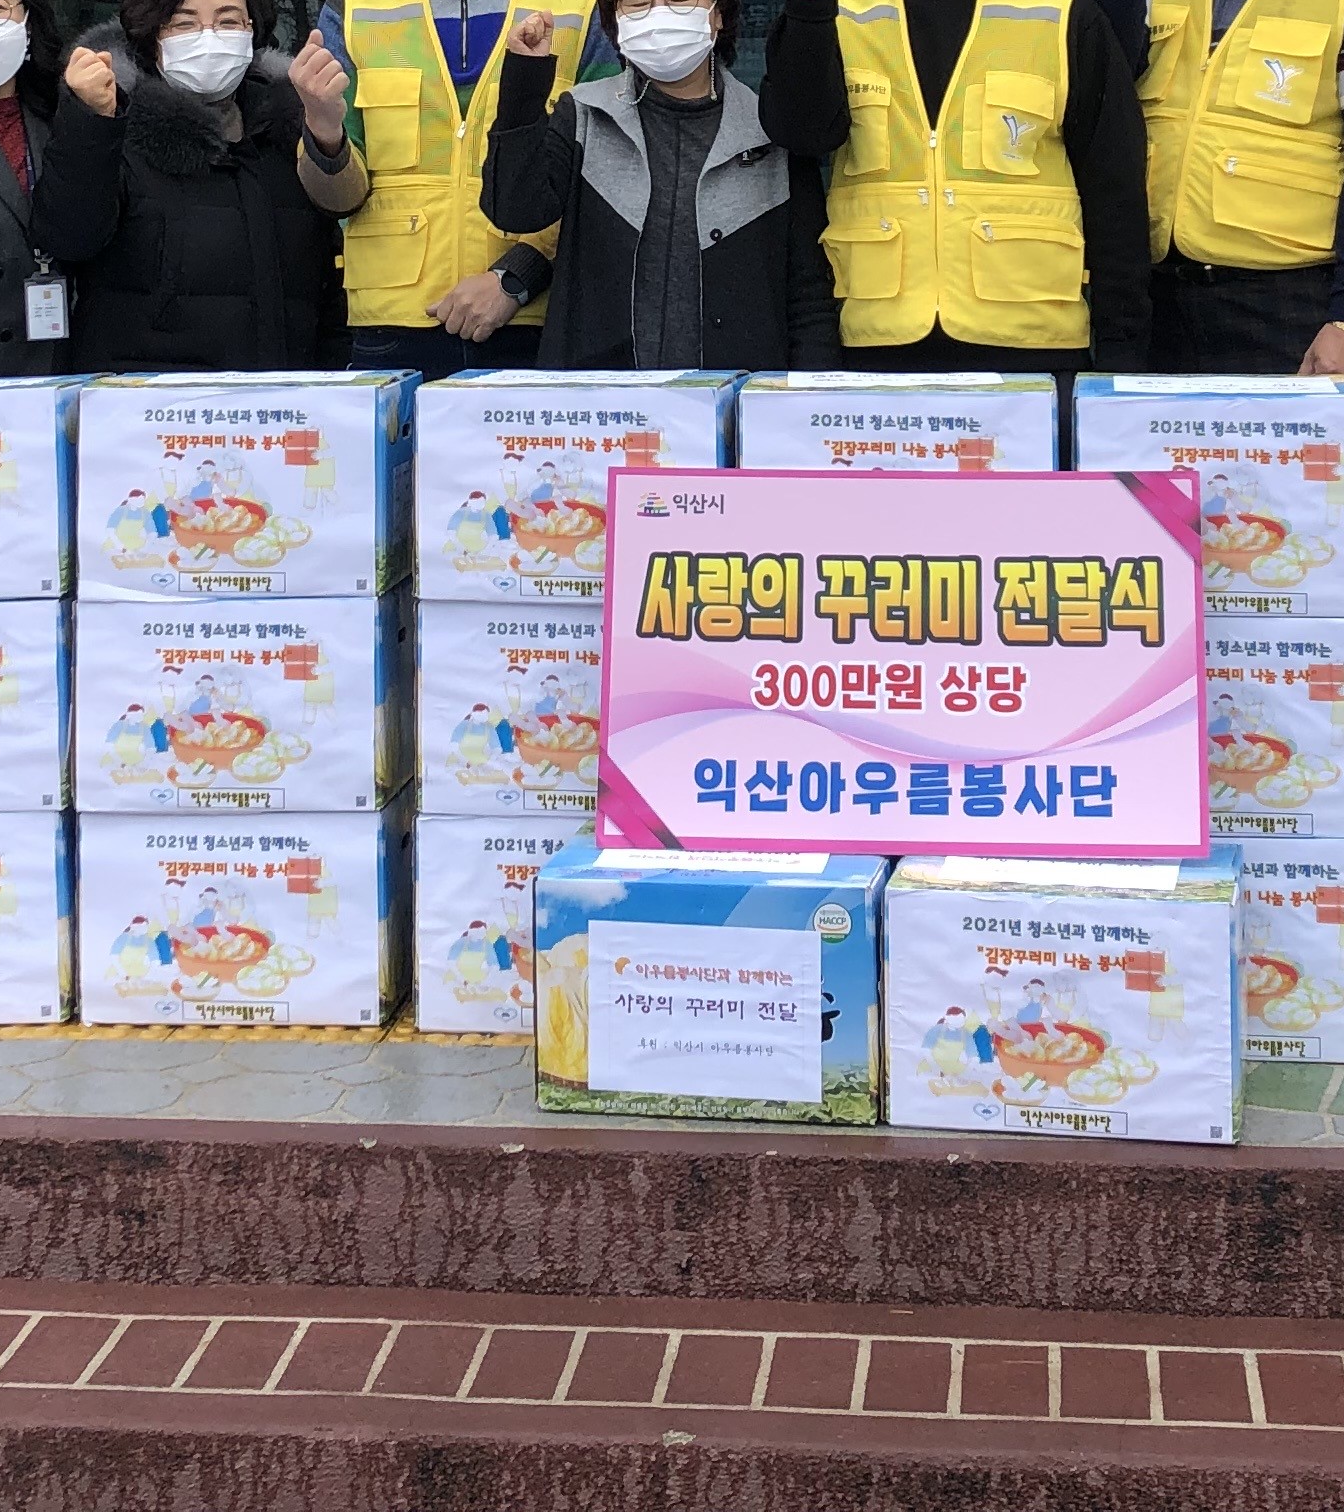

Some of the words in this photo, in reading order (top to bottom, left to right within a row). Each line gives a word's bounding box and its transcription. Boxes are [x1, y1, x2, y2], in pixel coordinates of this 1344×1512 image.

[144, 409, 196, 425] 2021년
[201, 409, 252, 425] 청소년과
[256, 409, 308, 425] 함께하는
[483, 409, 535, 426] 2021년
[540, 409, 592, 426] 청소년과
[595, 410, 648, 427] 함께하는
[810, 413, 864, 430] 2021년
[869, 414, 923, 432] 청소년과
[926, 416, 982, 433] 함께하는
[1149, 420, 1206, 437] 2021년
[1210, 420, 1267, 438] 청소년과
[1270, 421, 1327, 438] 함께하는
[232, 434, 257, 450] 나눔
[571, 436, 597, 452] 나눔
[902, 442, 929, 458] 나눔
[1245, 448, 1273, 464] 나눔
[673, 493, 725, 515] 익산시
[533, 579, 604, 597] 익산시아우름봉사
[636, 551, 803, 643] 사랑의
[815, 554, 983, 646] 꾸러미
[993, 555, 1165, 647] 전달식
[143, 622, 195, 639] 2021년
[199, 622, 251, 639] 청소년과
[254, 623, 307, 639] 함께하는
[487, 621, 539, 638] 2021년
[544, 622, 596, 640] 청소년과
[230, 649, 256, 665] 나눔
[575, 650, 601, 666] 나눔
[1215, 640, 1272, 657] 청소년과
[1275, 641, 1333, 658] 함께하는
[1206, 666, 1244, 684] 꾸러미
[1250, 668, 1278, 684] 나눔
[755, 664, 923, 710] 300만원
[940, 665, 1027, 713] 상당
[694, 758, 1118, 818] 익산아우름봉사단
[536, 793, 596, 812] 익산시아우름봉
[146, 834, 198, 851] 2021년
[202, 835, 254, 852] 청소년과
[258, 835, 310, 852] 함께하는
[484, 837, 536, 855] 2021년
[233, 862, 259, 877] 나눔
[1242, 861, 1279, 879] 소년과
[1282, 862, 1340, 881] 함께하는
[1257, 890, 1285, 906] 나눔
[819, 917, 846, 925] HACCP
[962, 916, 1022, 937] 2021년
[1027, 920, 1086, 940] 청소년과
[1090, 924, 1151, 945] 함께하는
[1063, 952, 1093, 971] 나눔
[615, 993, 673, 1016] 사랑의
[685, 998, 744, 1020] 꾸러미
[758, 1001, 797, 1022] 전달
[673, 1040, 704, 1053] 익산시
[1246, 1038, 1307, 1058] 아우름봉사단
